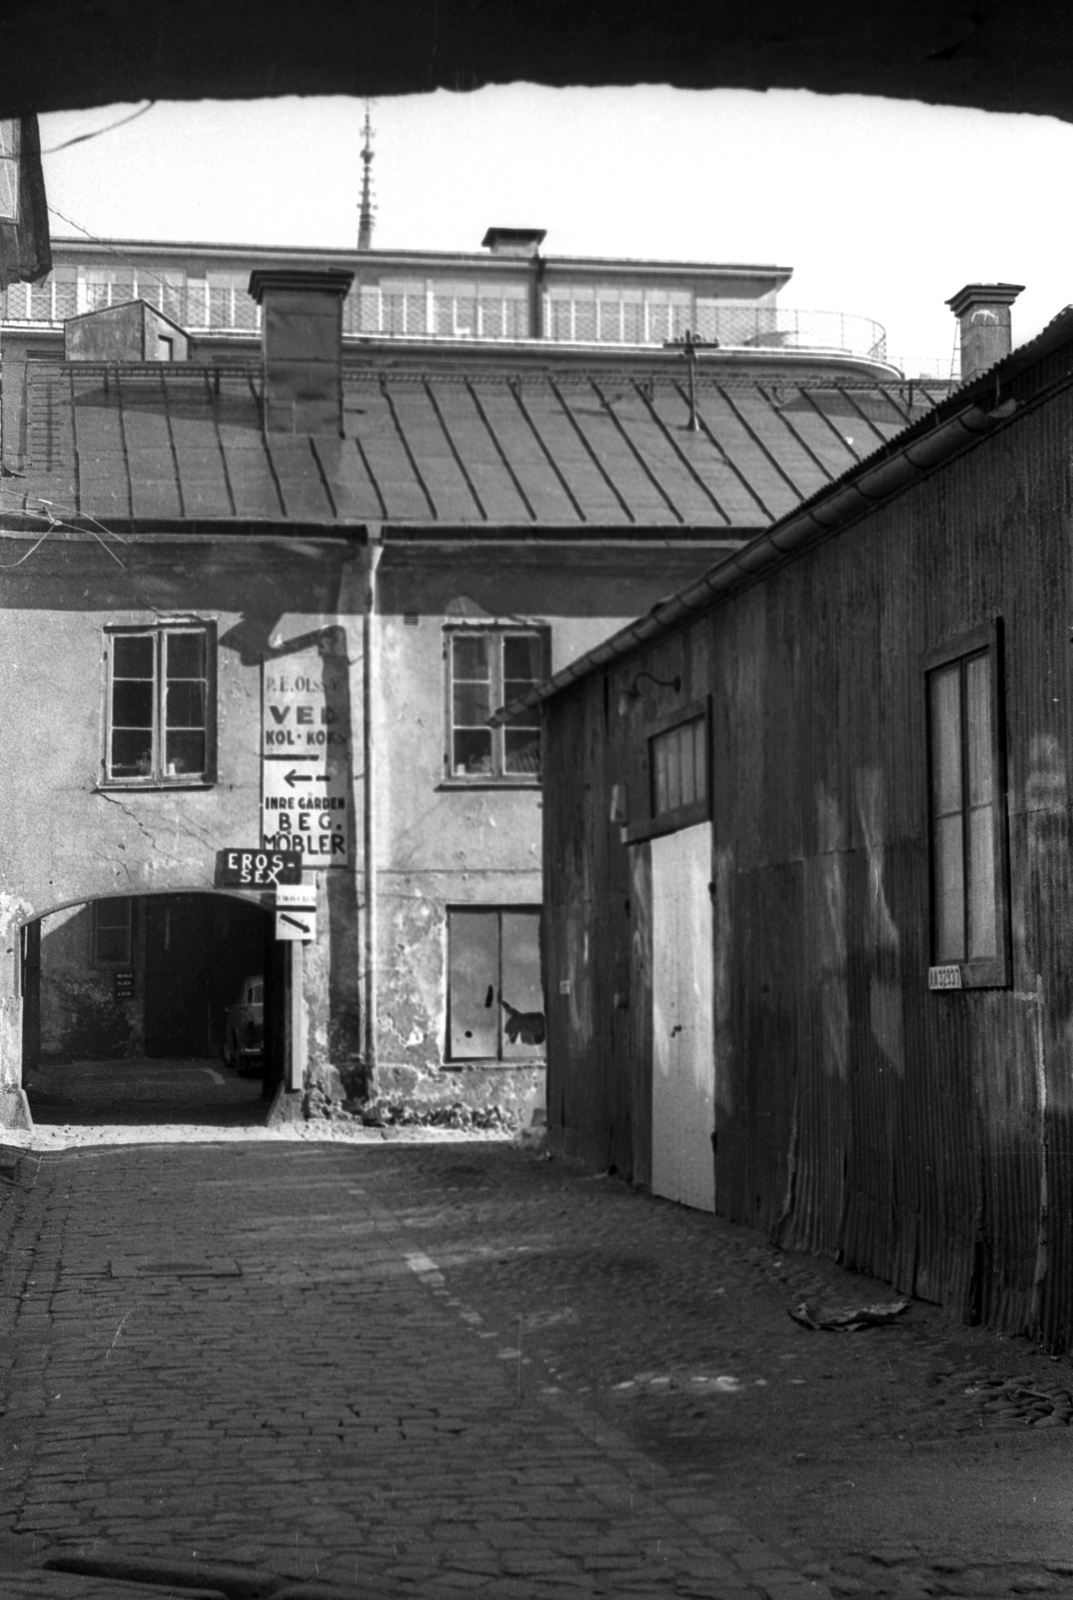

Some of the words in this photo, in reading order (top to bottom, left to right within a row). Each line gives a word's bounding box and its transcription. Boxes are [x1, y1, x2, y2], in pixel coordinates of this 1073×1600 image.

[269, 705, 336, 725] VED
[265, 797, 295, 810] INRE
[279, 812, 342, 831] BEG.
[263, 831, 346, 855] MÖBLER
[240, 868, 281, 884] SEX
